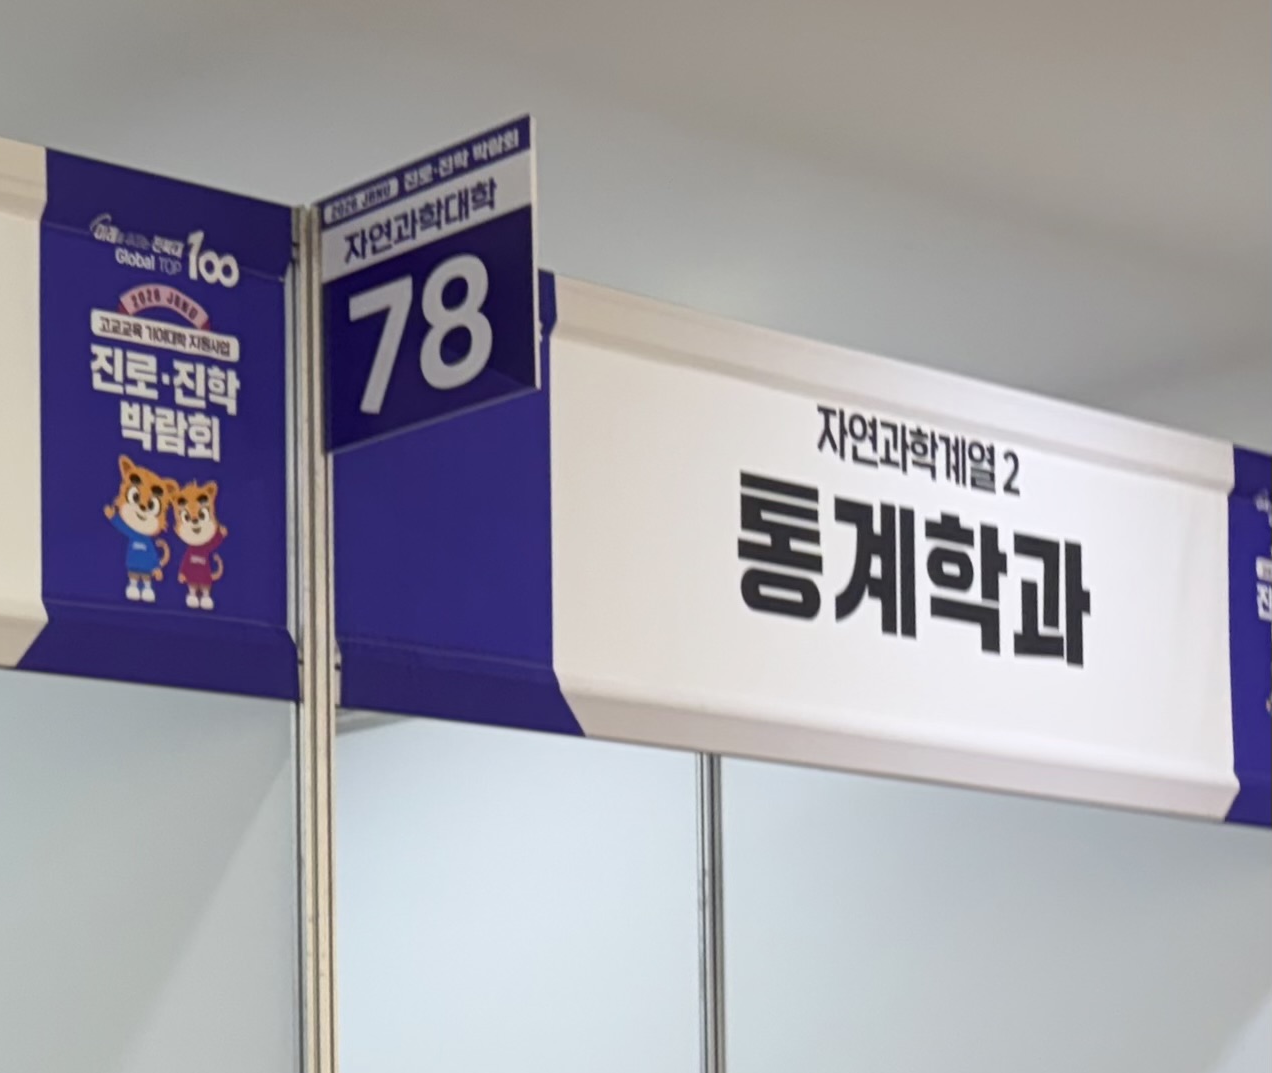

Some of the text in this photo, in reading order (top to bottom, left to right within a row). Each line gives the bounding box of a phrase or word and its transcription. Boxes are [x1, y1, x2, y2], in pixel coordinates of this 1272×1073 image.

[473, 128, 519, 162] 박람회
[344, 177, 498, 264] 자연과학대학
[115, 230, 239, 287] Global TOP 100
[99, 315, 231, 358] 고교교육 기여대학 지원사업
[166, 290, 199, 321] JBNU
[349, 253, 493, 415] 78
[90, 343, 241, 416] 진로·진학
[120, 401, 221, 462] 박람회
[817, 403, 1021, 497] 자연과학계열 2
[737, 469, 1091, 669] 통계학과
